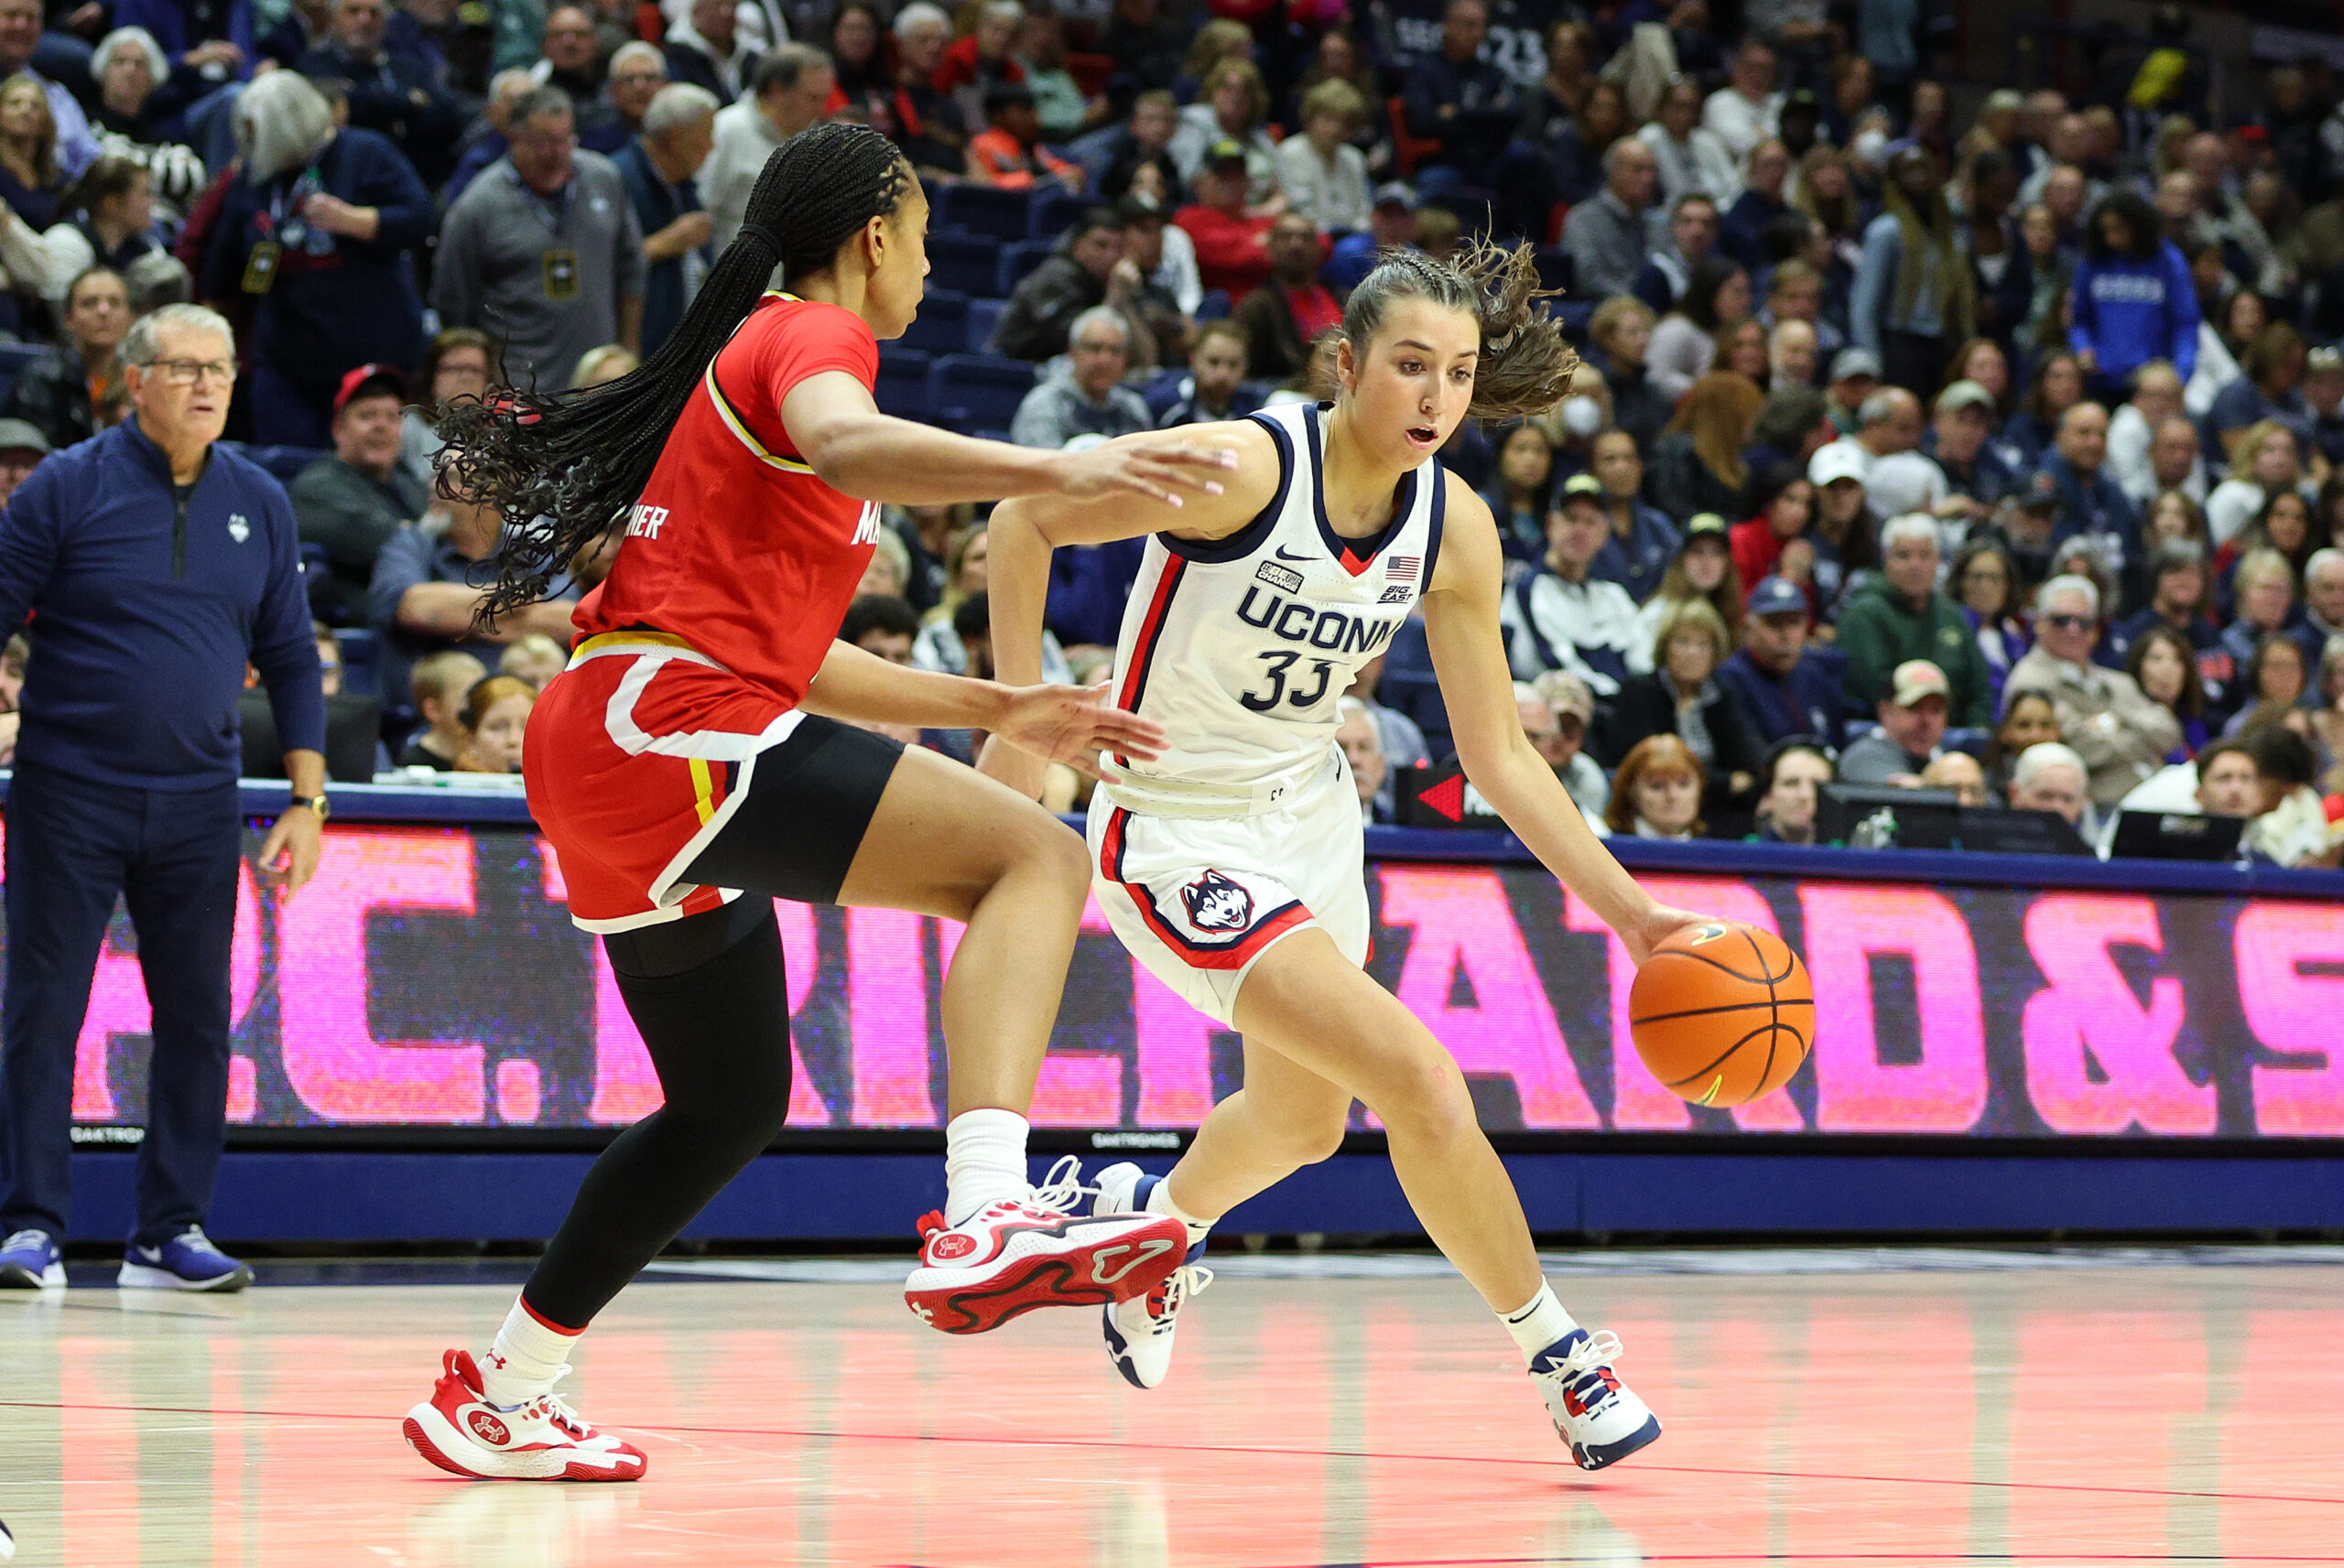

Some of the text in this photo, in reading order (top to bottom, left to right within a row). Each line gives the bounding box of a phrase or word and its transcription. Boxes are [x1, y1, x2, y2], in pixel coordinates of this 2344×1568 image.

[1257, 571, 1298, 592] CHANGE
[1385, 585, 1411, 594] BIG
[1380, 593, 1414, 601] EAST
[1241, 650, 1342, 711] 33
[2022, 892, 2218, 1135] &
